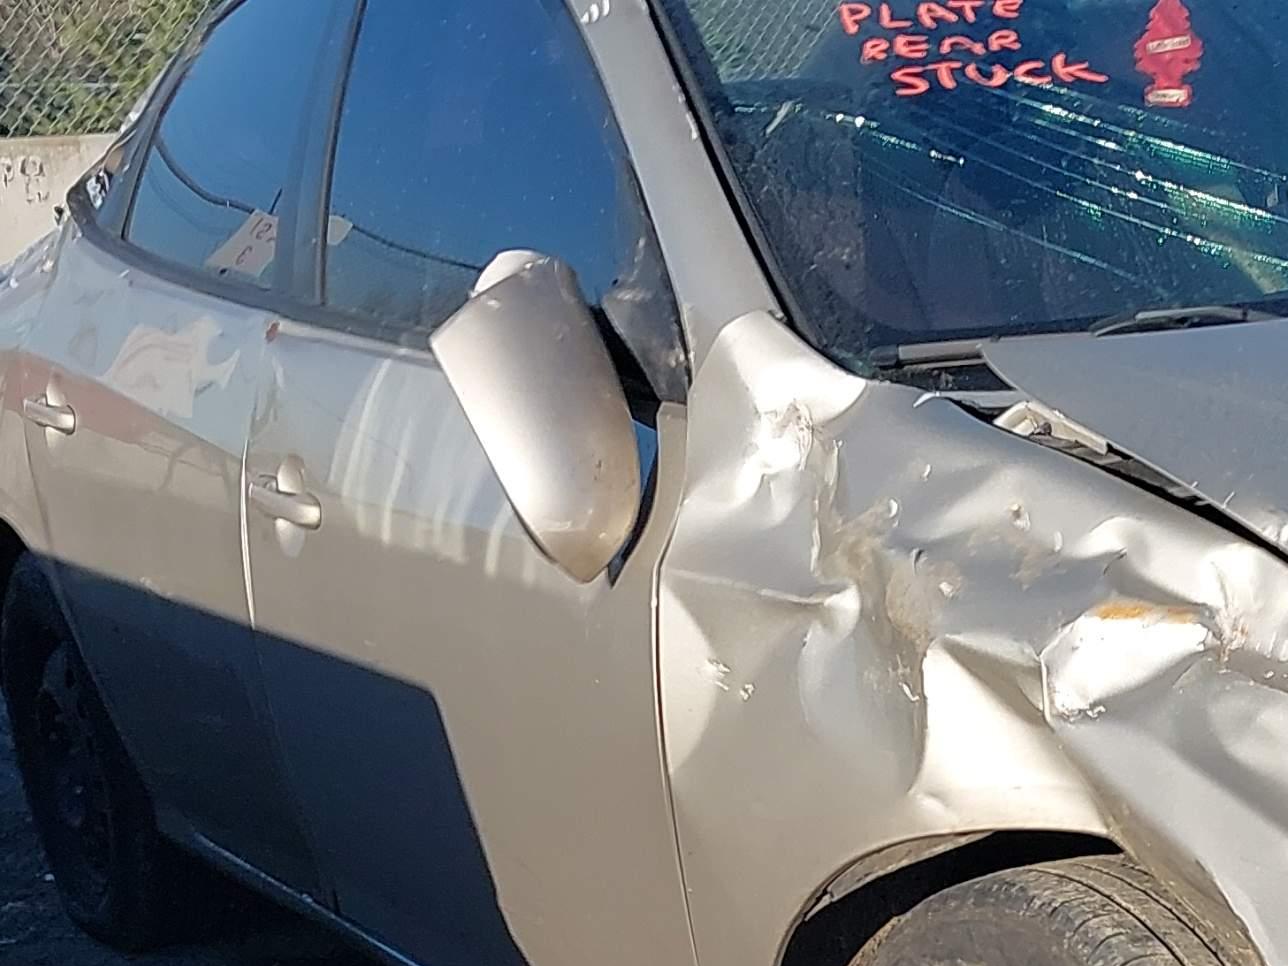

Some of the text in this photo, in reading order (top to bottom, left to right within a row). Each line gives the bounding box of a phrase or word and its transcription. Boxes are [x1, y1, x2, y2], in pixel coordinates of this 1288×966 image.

[839, 0, 1022, 34] PLATE
[860, 29, 1021, 64] REAR
[891, 53, 1108, 96] STUCK
